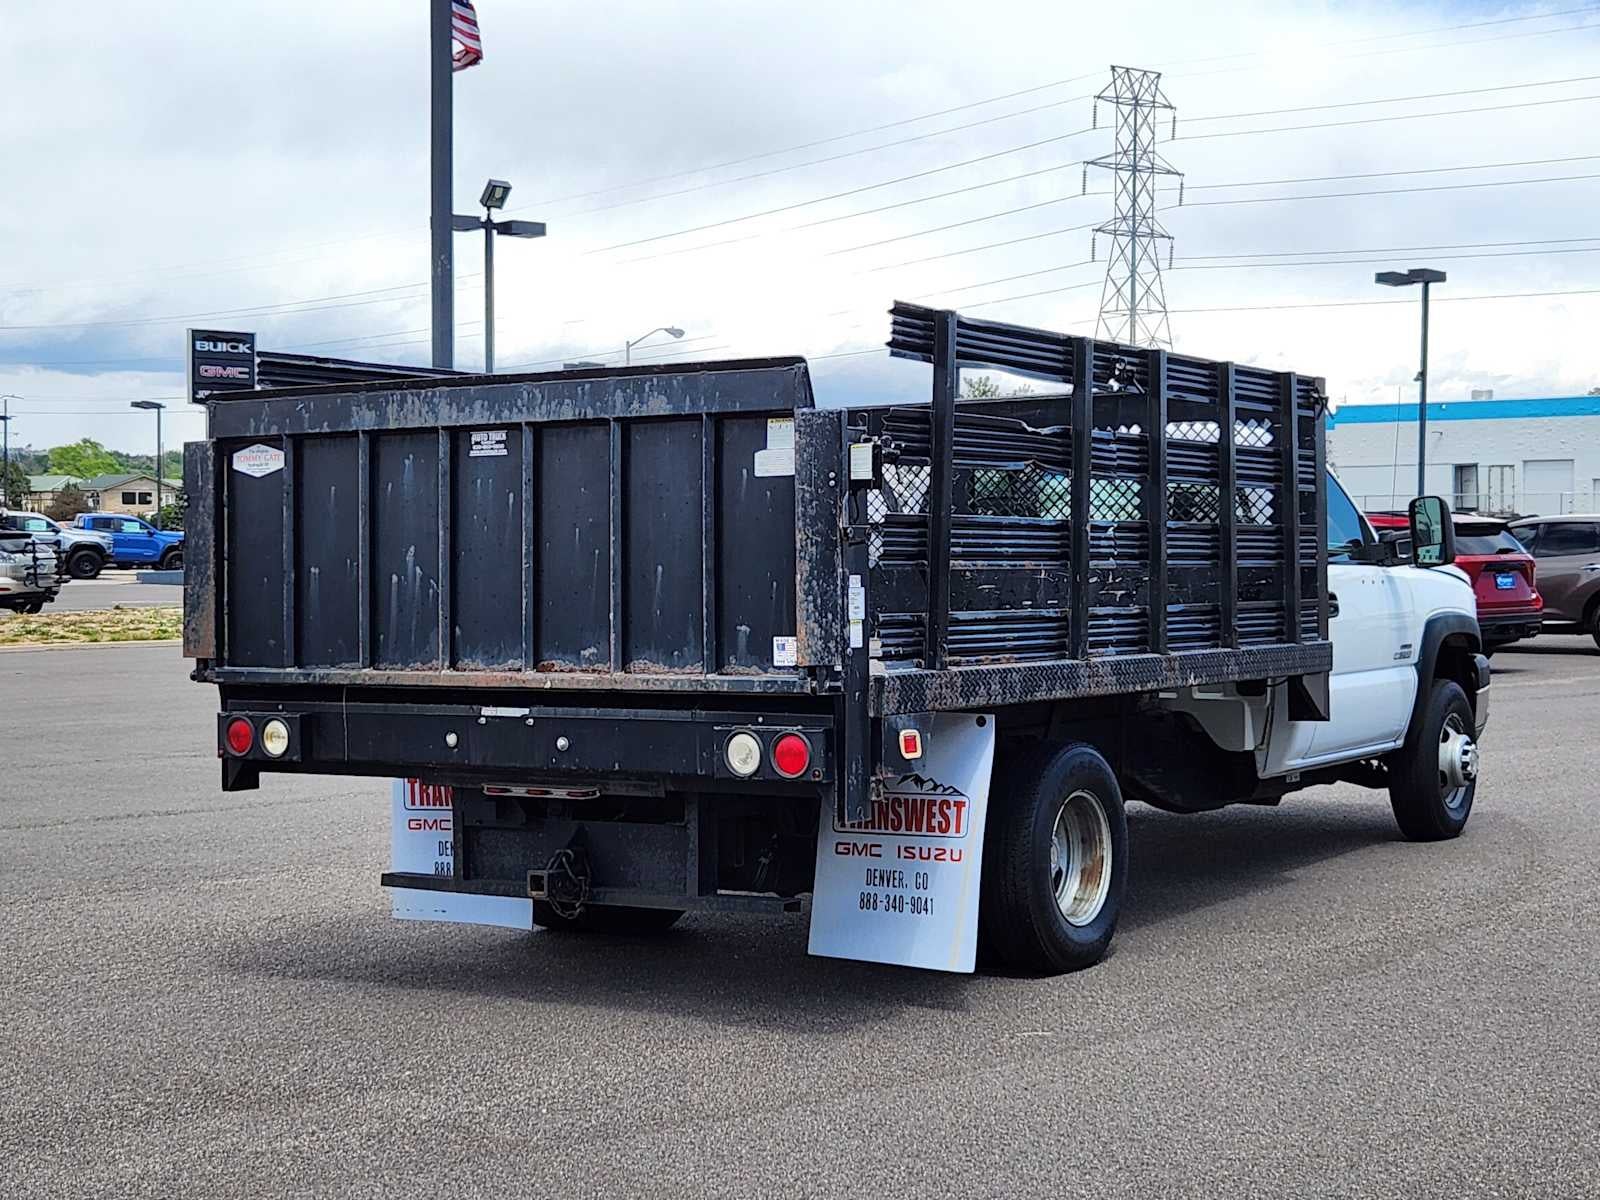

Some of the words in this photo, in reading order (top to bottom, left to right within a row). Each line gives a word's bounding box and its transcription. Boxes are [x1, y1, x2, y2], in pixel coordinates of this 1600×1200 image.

[195, 340, 252, 353] BUICK
[200, 365, 249, 378] GMC
[408, 819, 452, 830] GMC
[839, 797, 967, 834] NSWEST
[835, 842, 882, 858] GMC
[897, 845, 963, 862] ISUZU
[915, 872, 929, 891] CO
[859, 892, 934, 916] 888-340-9041
